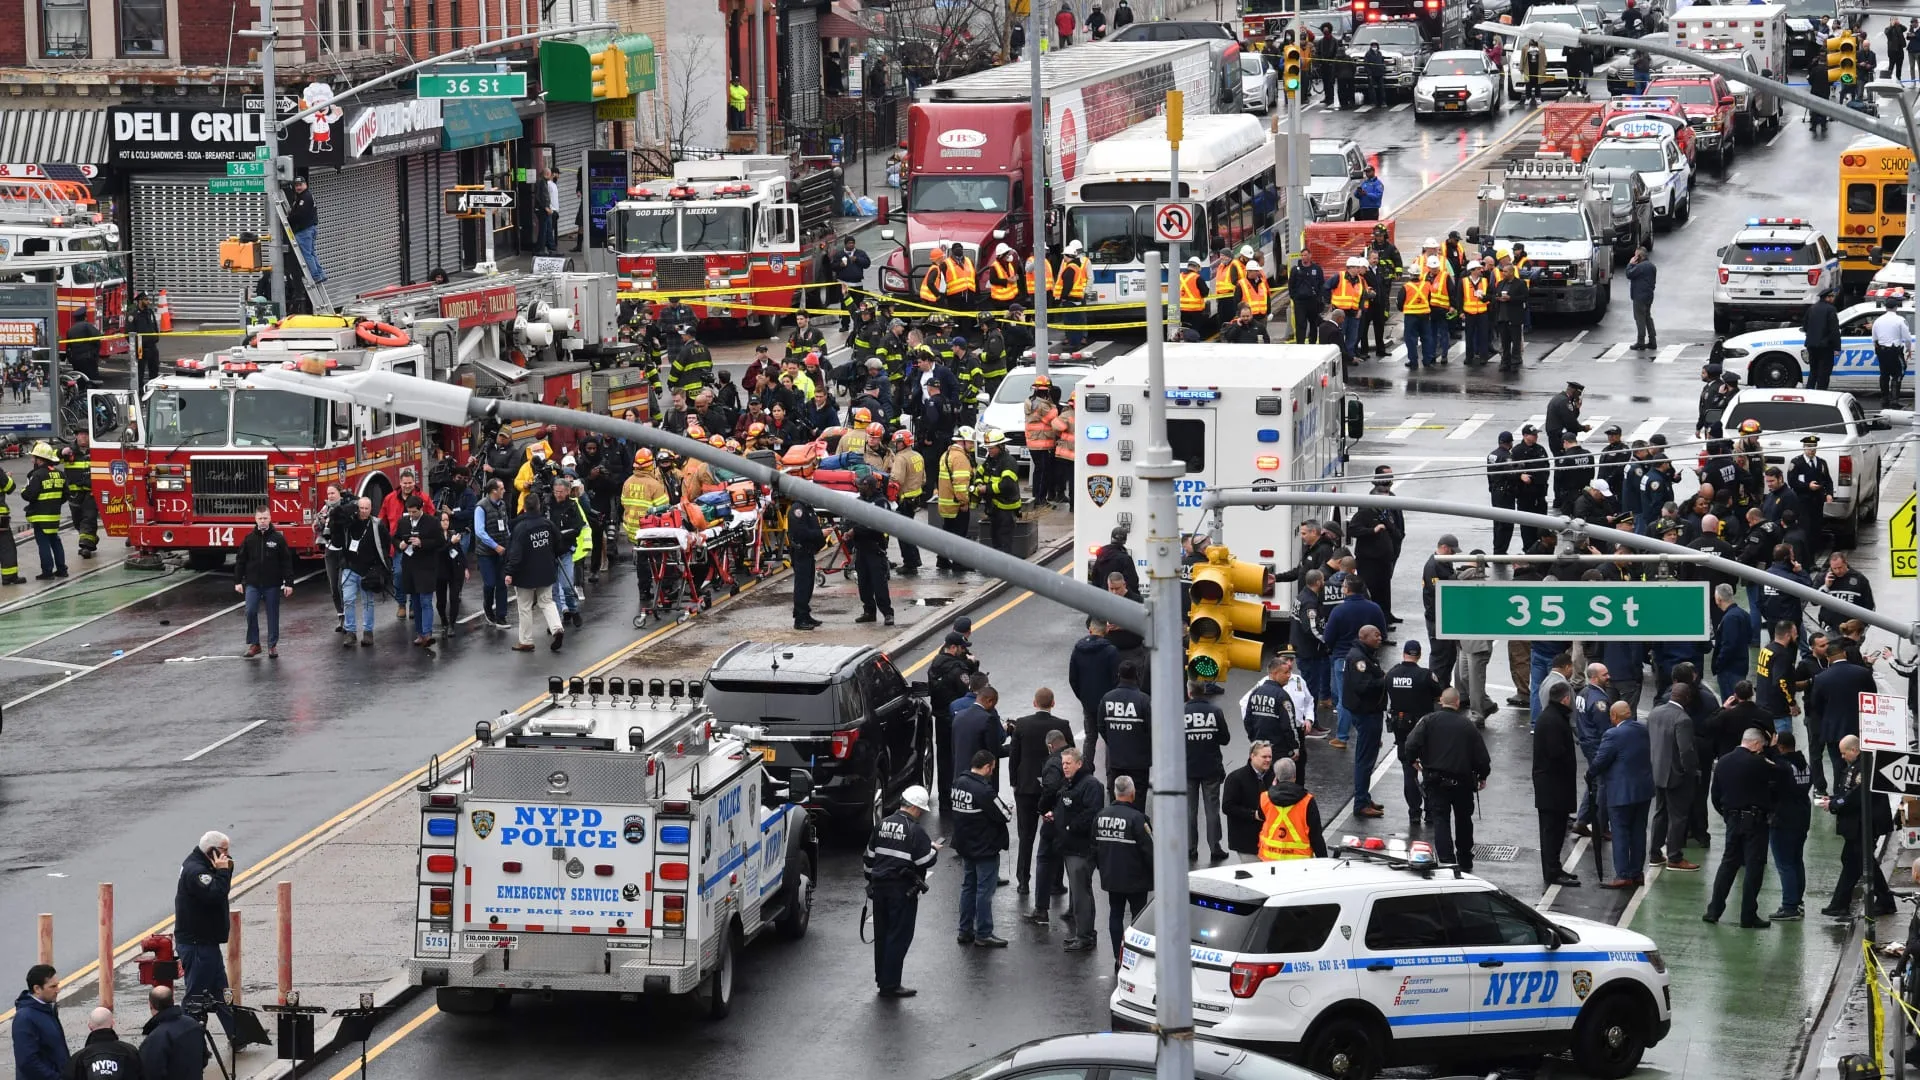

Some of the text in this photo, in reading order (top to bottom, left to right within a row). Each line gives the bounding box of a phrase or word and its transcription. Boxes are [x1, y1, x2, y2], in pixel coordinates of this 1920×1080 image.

[446, 79, 500, 93] 36 St
[114, 112, 180, 141] DELI
[356, 112, 376, 152] KING
[946, 134, 977, 142] JBS
[120, 151, 130, 159] HOT
[136, 151, 149, 159] COLD
[151, 151, 183, 159] SANDWICHES
[239, 152, 255, 160] LUNCH
[0, 164, 10, 175] &
[233, 164, 246, 174] 36
[1882, 158, 1910, 170] SCHOO
[445, 293, 515, 318] LADDER 114 TALLY HO
[1167, 390, 1215, 398] EMERGE
[1720, 464, 1735, 476] NYPD
[1173, 481, 1206, 492] YPD
[157, 499, 190, 512] F.D.
[1176, 495, 1202, 507] LIC
[105, 504, 123, 513] JIMMY
[208, 527, 234, 546] 114
[530, 531, 549, 541] NYPD
[1506, 595, 1639, 627] 35 St
[1393, 678, 1412, 686] NYPD
[1251, 696, 1275, 707] NYPD
[1106, 701, 1137, 717] PBA
[1251, 705, 1274, 713] POLICE
[1184, 713, 1216, 727] PBA
[1110, 723, 1132, 731] NYPD
[718, 785, 741, 826] POLICE
[515, 807, 603, 827] NYPD
[881, 822, 904, 833] MTA
[501, 828, 616, 848] POLICE
[893, 832, 906, 841] UNIT
[765, 831, 781, 871] NYPD
[497, 886, 619, 902] EMERGENCY SERVICE
[485, 906, 521, 914] KEEP
[426, 937, 448, 946] 5751
[1130, 933, 1150, 946] NYPD
[1190, 949, 1223, 962] OLICE
[1609, 951, 1637, 961] POLICE
[1319, 961, 1331, 970] ESU
[1333, 960, 1346, 970] K-9
[1483, 970, 1559, 1006] NYPD
[92, 1059, 118, 1072] NYPD
